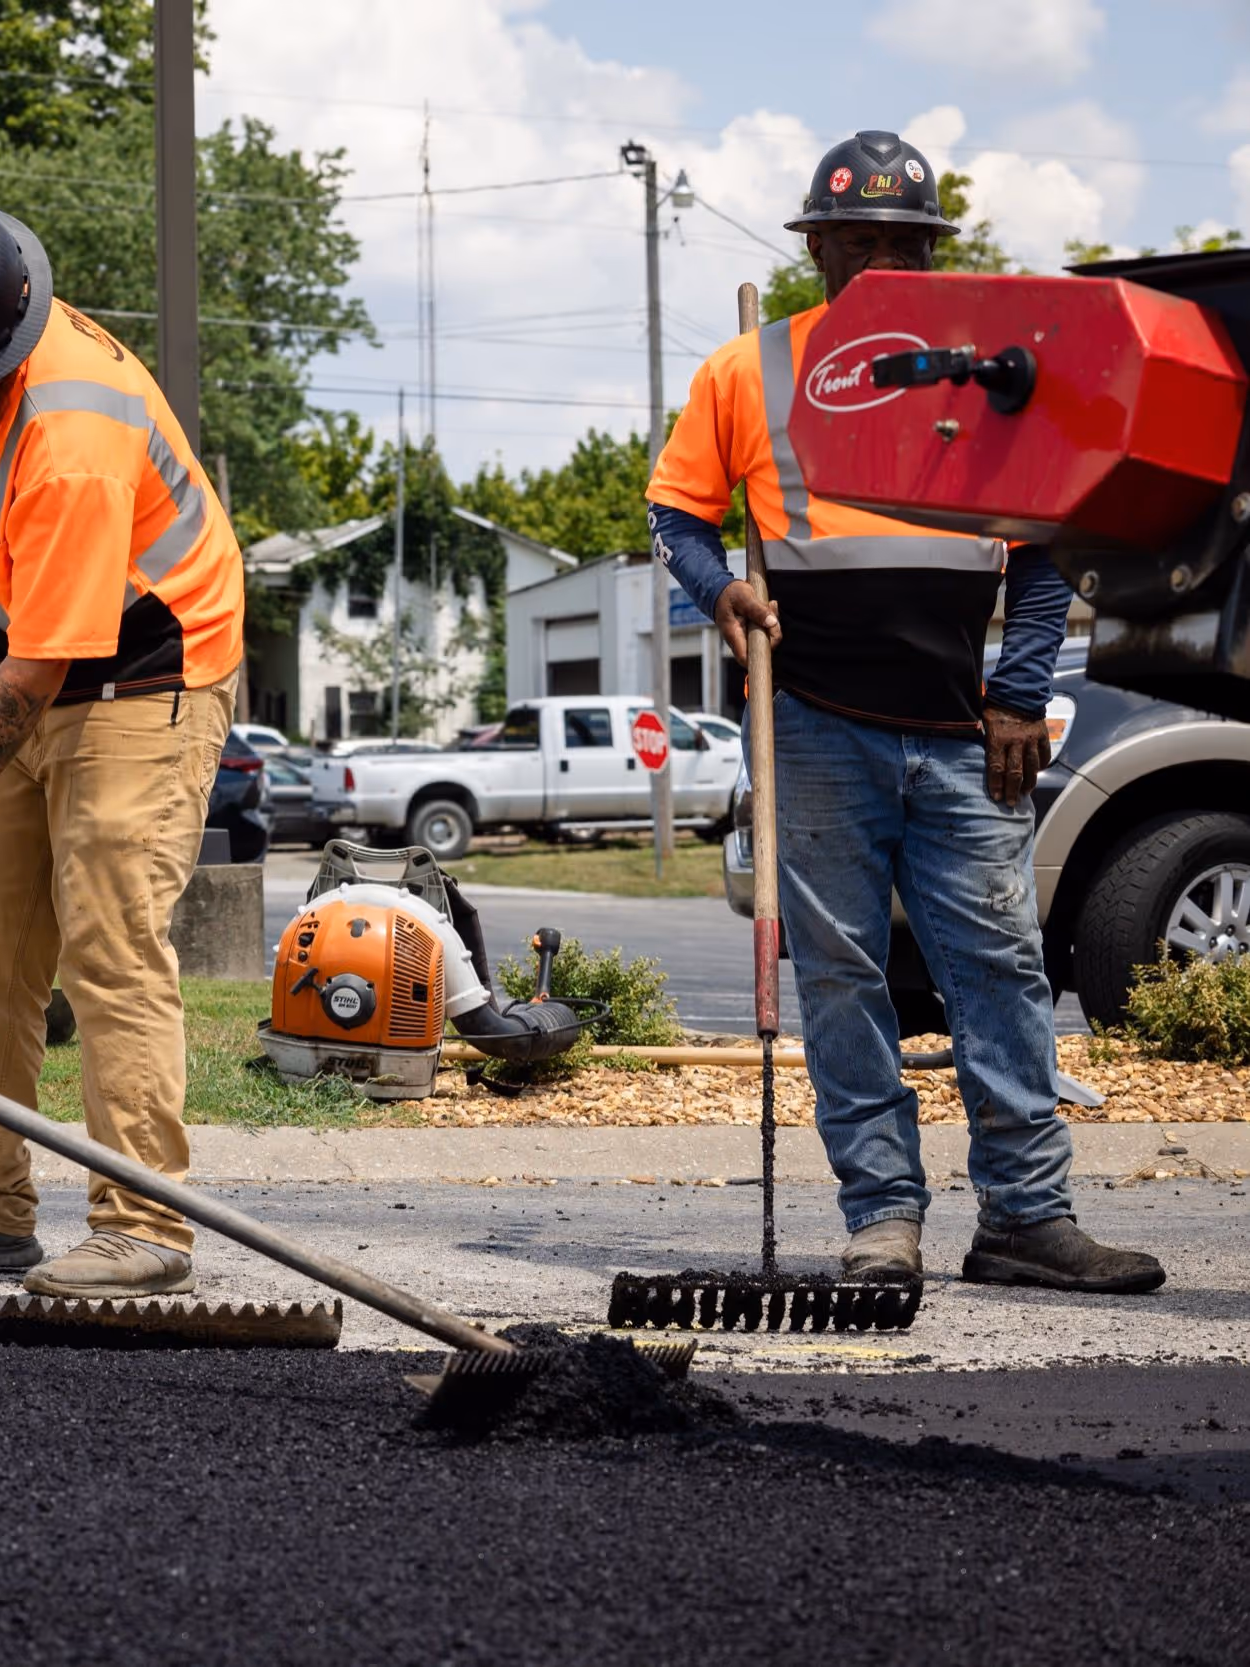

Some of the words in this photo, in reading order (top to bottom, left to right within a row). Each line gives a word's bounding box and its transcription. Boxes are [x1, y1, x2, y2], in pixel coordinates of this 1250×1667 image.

[867, 175, 892, 188] PRI
[633, 727, 666, 755] STOP
[333, 996, 357, 1005] STIHL
[326, 1056, 369, 1070] STIHL
